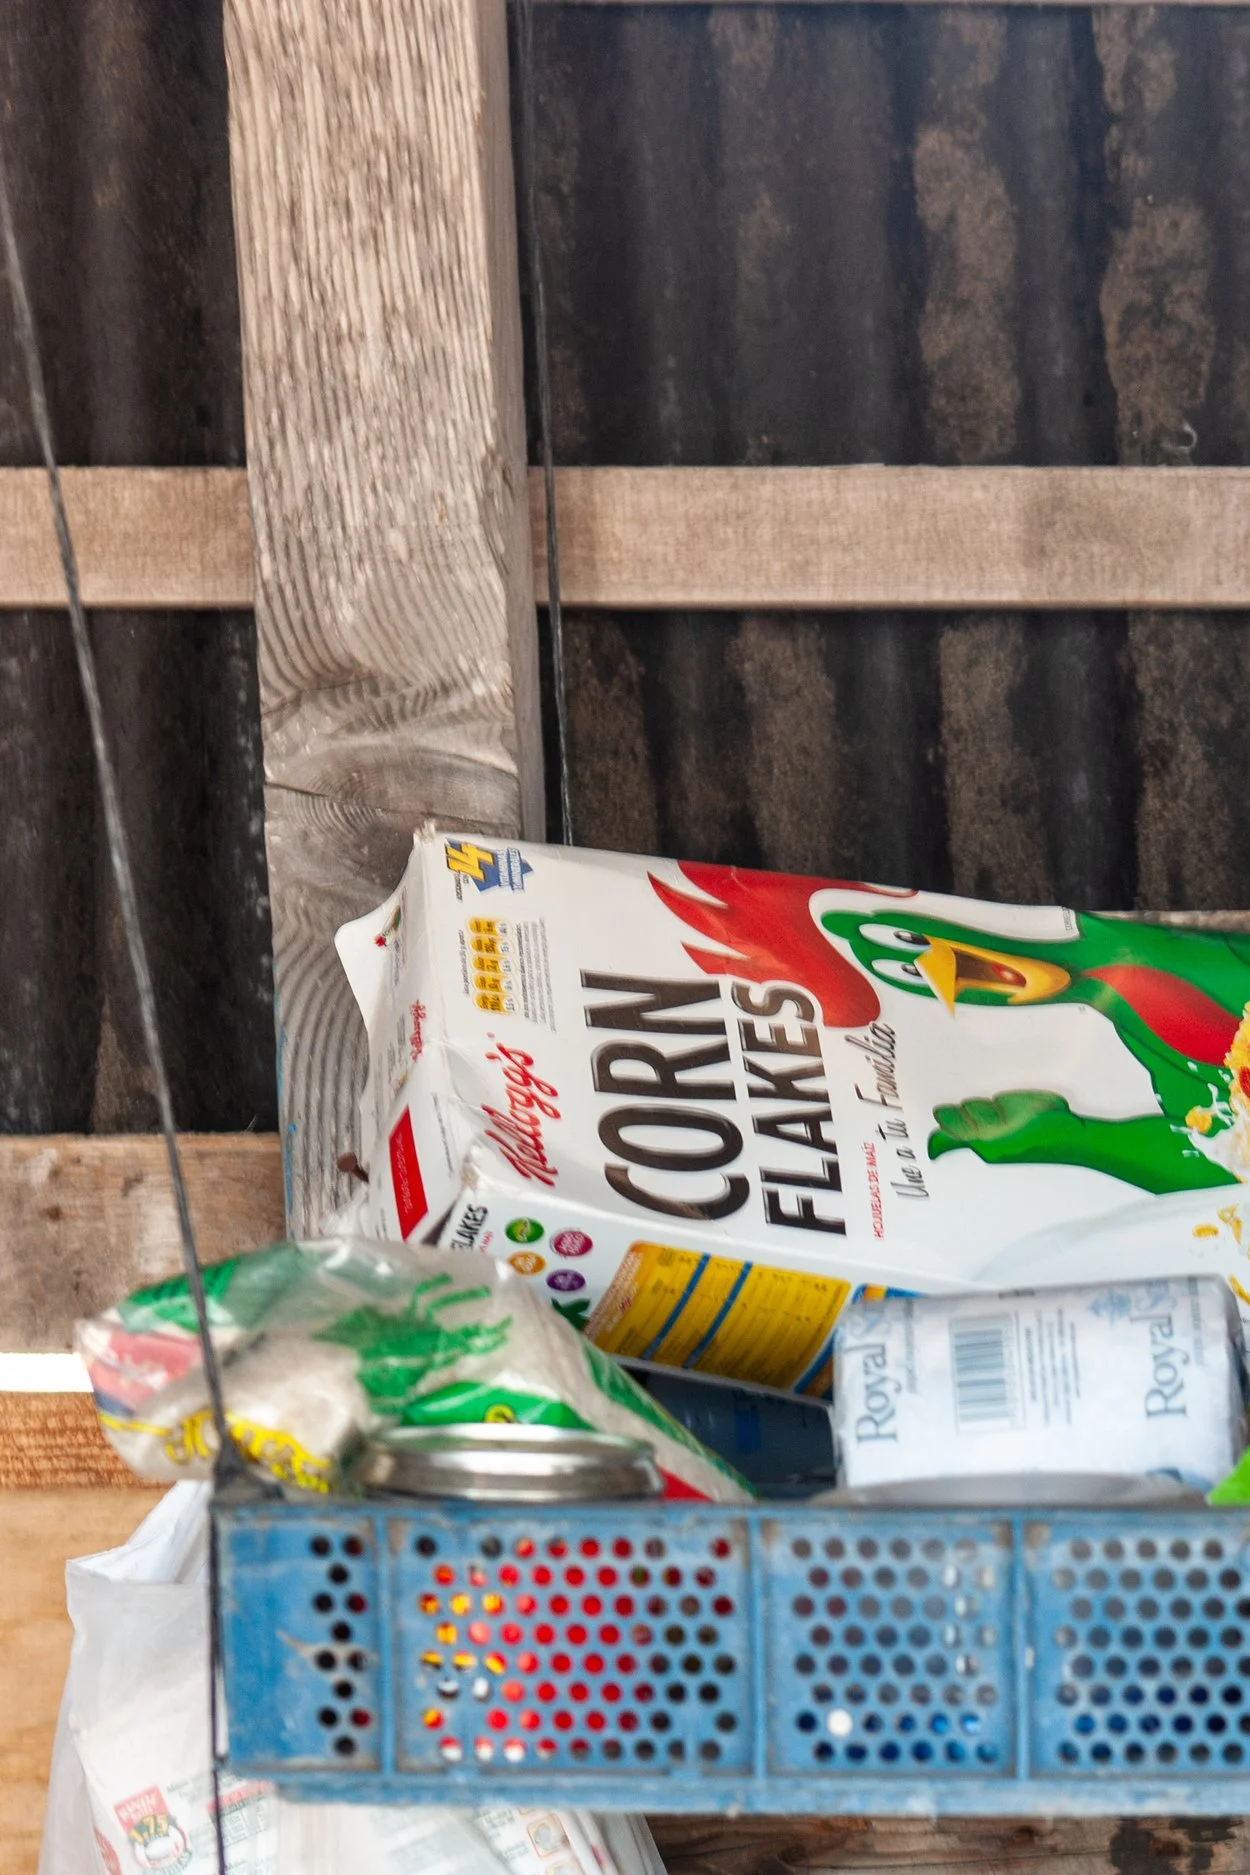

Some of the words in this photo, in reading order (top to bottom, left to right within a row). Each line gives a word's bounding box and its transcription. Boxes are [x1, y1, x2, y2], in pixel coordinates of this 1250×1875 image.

[444, 841, 495, 882] 14
[580, 968, 750, 1221] CORN
[731, 979, 847, 1236] FLAKES
[843, 1020, 904, 1112] Familia
[480, 1040, 562, 1188] Kellogg's
[875, 1117, 910, 1142] tu
[896, 1146, 916, 1160] a
[866, 1169, 879, 1183] DE
[889, 1164, 930, 1199] Une
[842, 1342, 902, 1446] Royal
[1129, 1311, 1190, 1420] Royal
